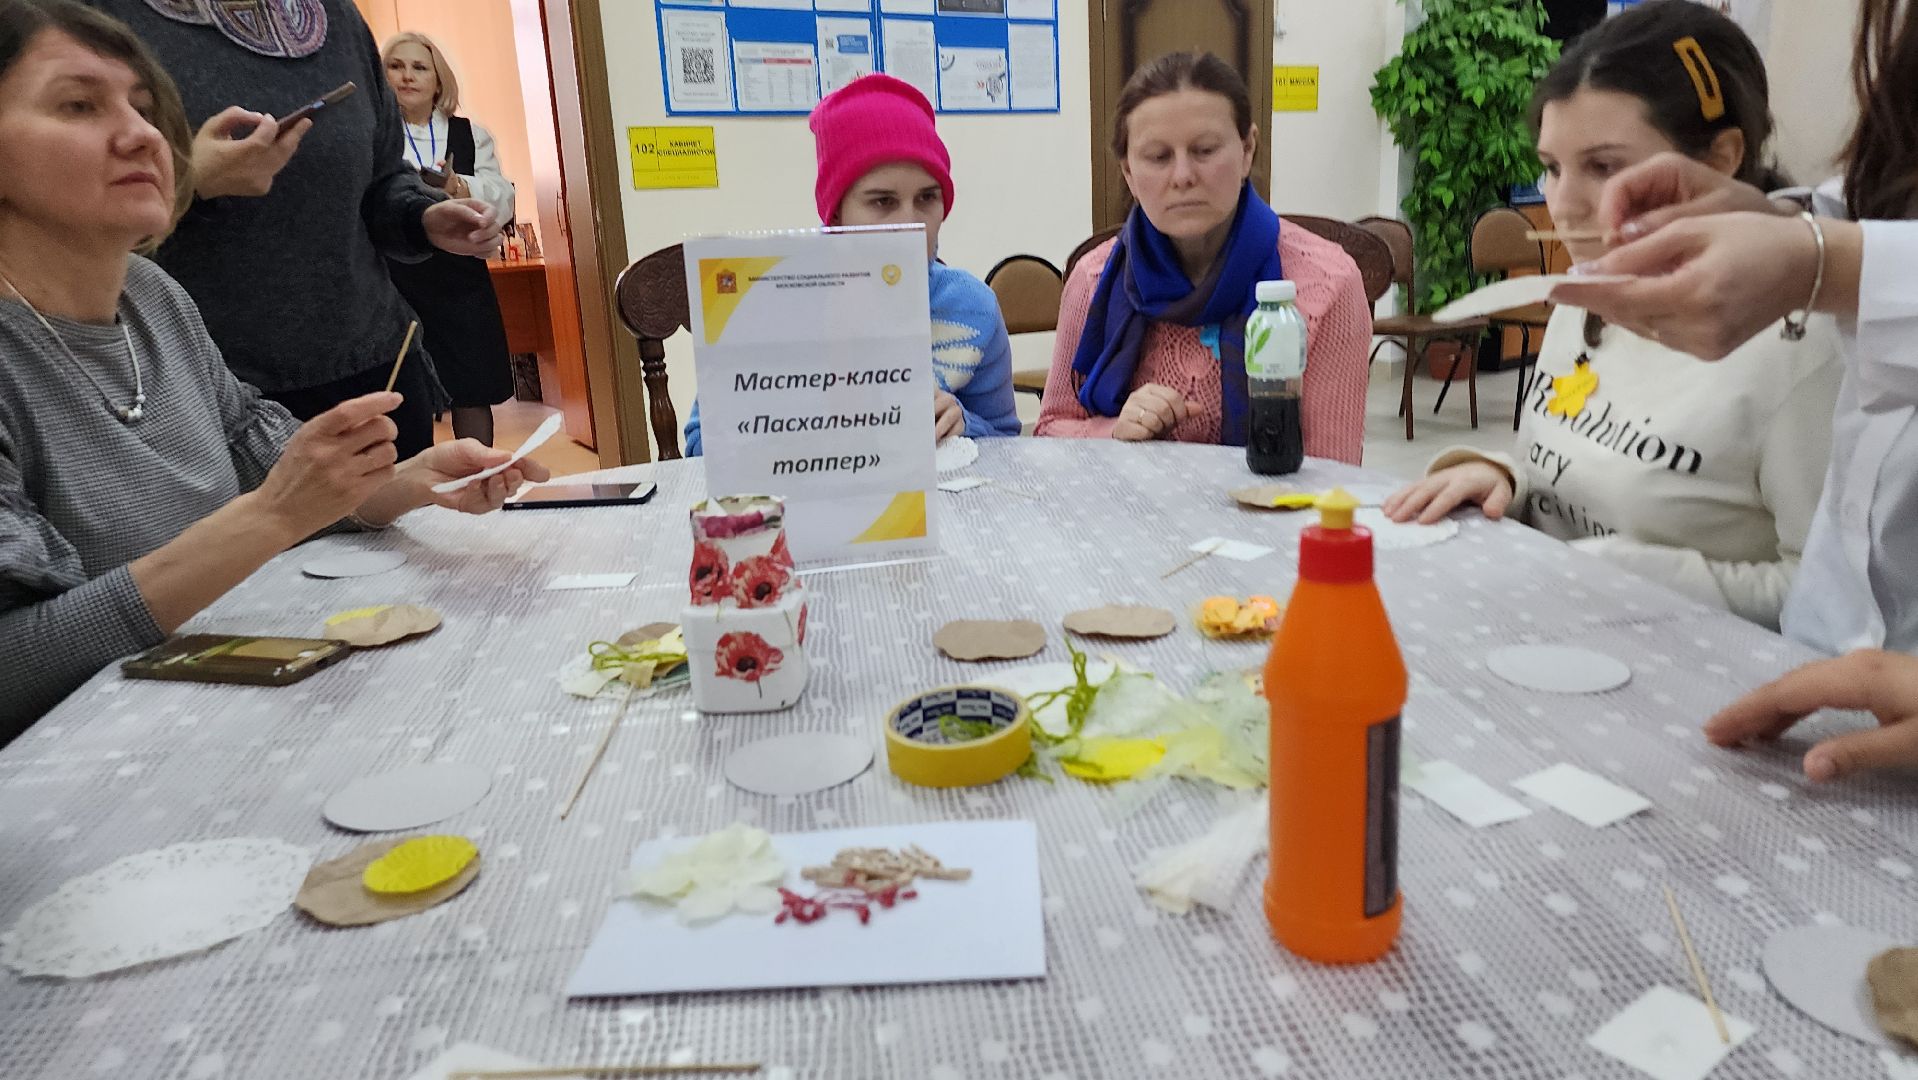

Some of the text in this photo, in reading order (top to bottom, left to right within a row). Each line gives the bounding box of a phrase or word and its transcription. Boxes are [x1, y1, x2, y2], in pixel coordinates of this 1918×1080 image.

[634, 143, 655, 154] 102
[733, 367, 912, 392] Мастер-класс
[737, 406, 901, 434] «Пасхальный
[772, 453, 881, 475] топпер»
[1529, 442, 1572, 487] ary
